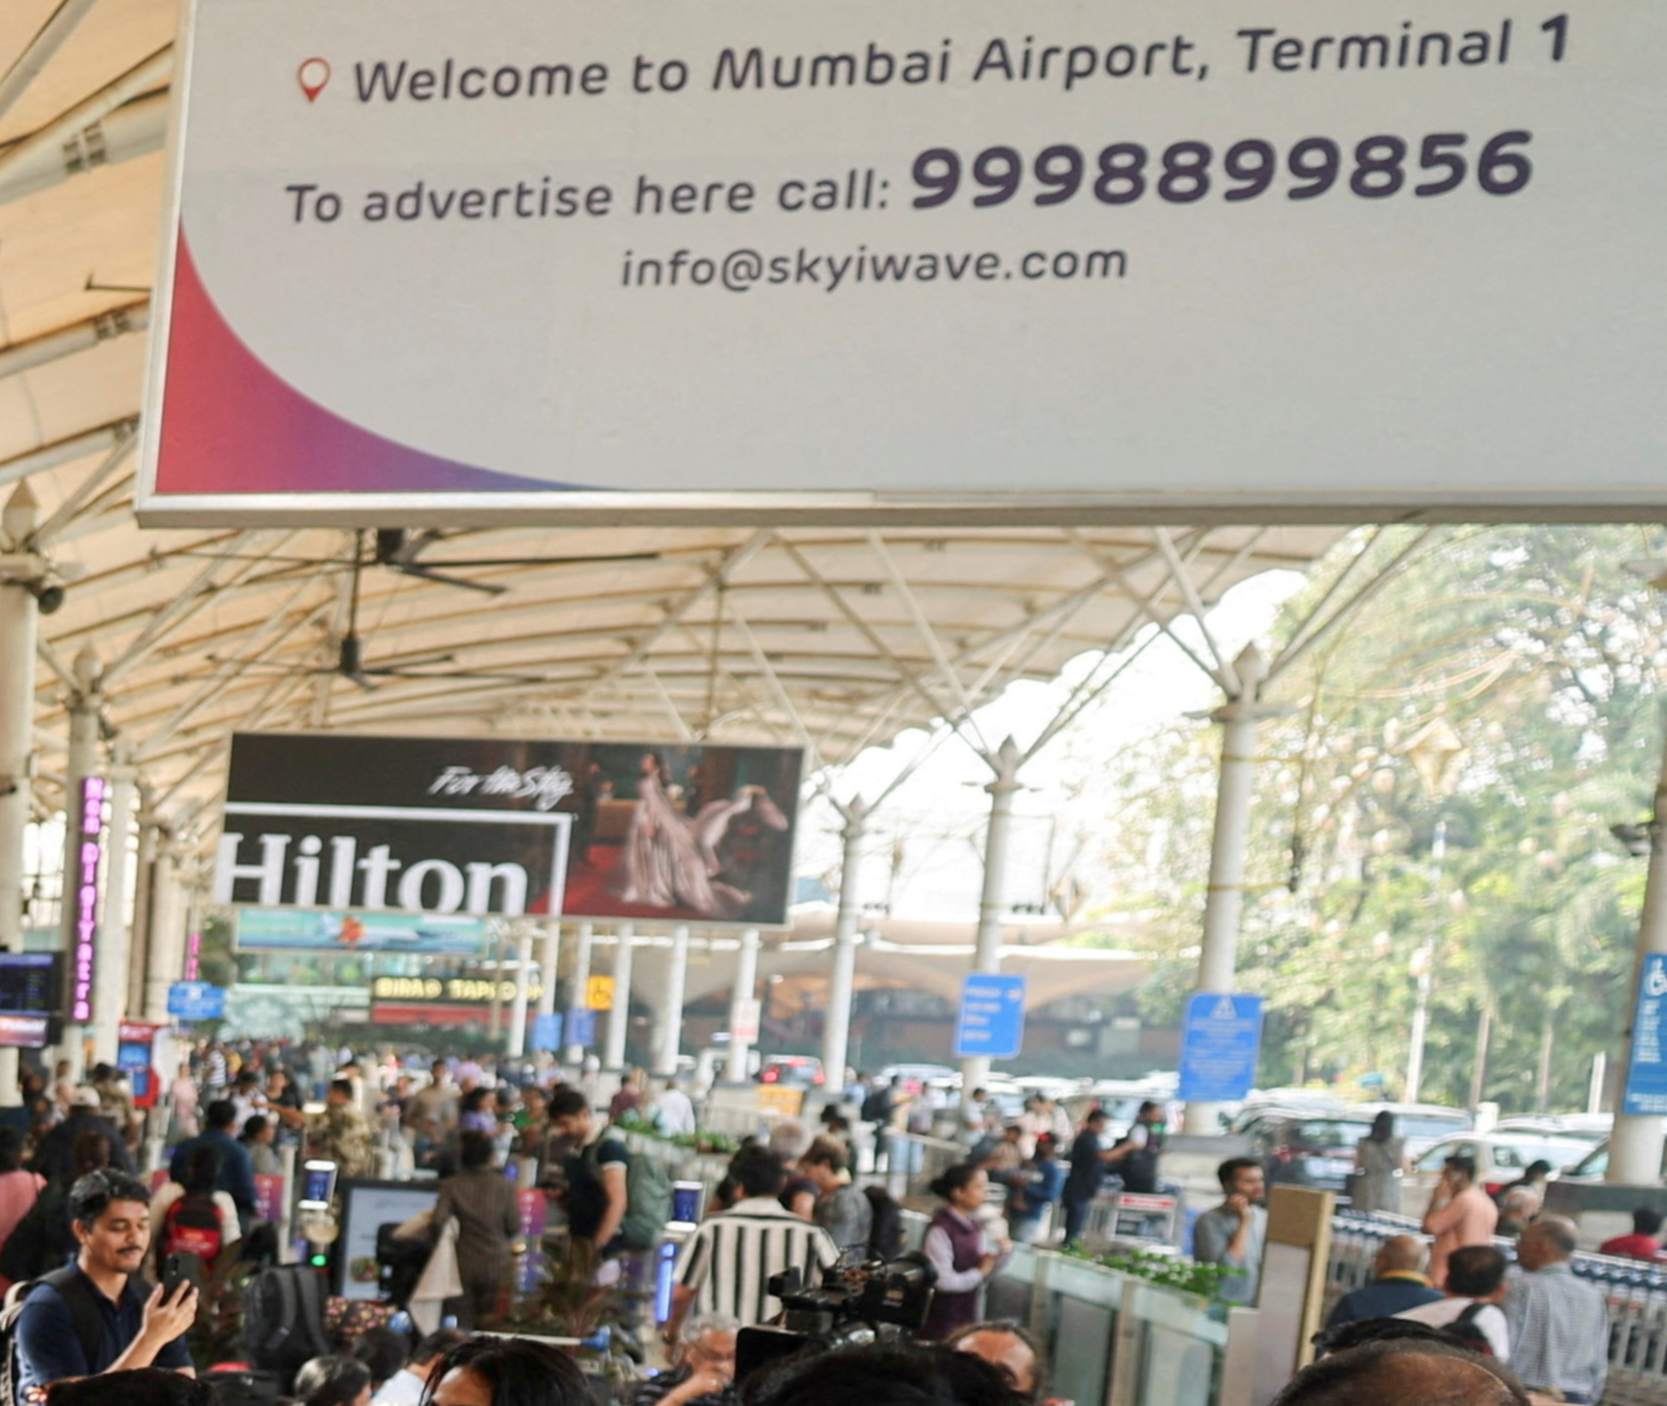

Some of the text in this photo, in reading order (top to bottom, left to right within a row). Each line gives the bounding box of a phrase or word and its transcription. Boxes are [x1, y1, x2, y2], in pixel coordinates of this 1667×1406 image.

[353, 13, 1569, 104] Welcome to Mumbai Airport, Terminal 1
[285, 130, 1533, 225] To advertise here call: 9998899856
[620, 244, 1128, 292] info@skyiwave.com
[217, 832, 528, 913] Hilton
